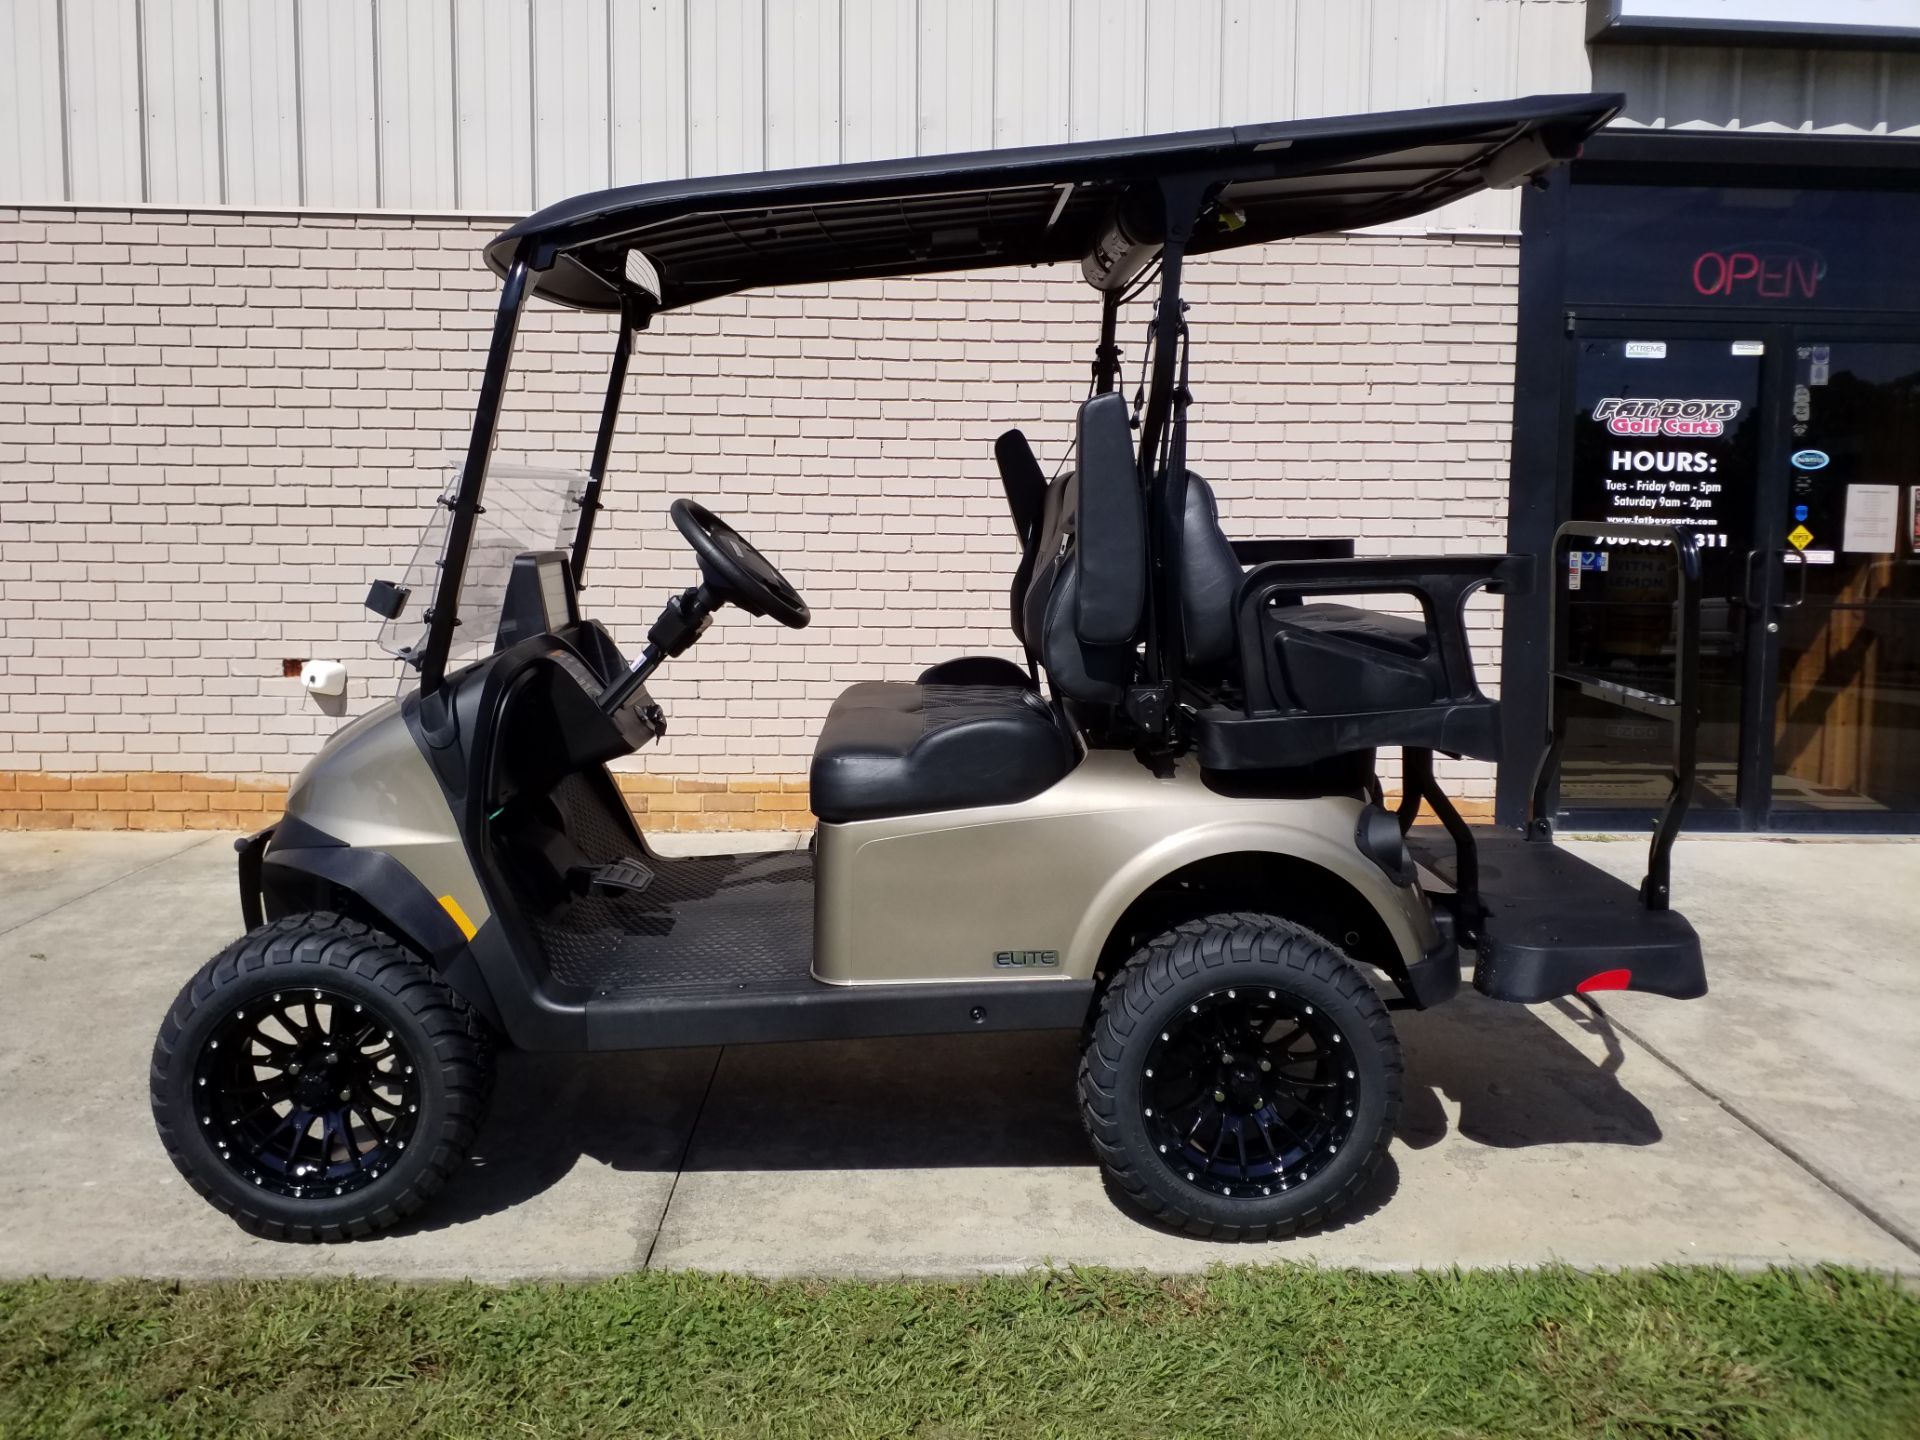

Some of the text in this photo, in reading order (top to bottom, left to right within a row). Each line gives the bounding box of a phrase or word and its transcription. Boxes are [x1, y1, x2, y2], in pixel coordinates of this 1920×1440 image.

[1693, 252, 1818, 298] OPEN
[1628, 345, 1665, 353] XTREME
[1612, 418, 1721, 434] Golf Carts
[1612, 450, 1717, 473] HOURS:
[1606, 480, 1627, 491] Tues
[1636, 481, 1666, 494] Friday
[1669, 481, 1690, 492] 9am
[1700, 482, 1721, 494] 5pm
[1614, 496, 1657, 509] Saturday
[1659, 497, 1680, 508] 9am
[1690, 498, 1712, 510] 2pm
[1606, 515, 1718, 526] www.fatboyscarts.com
